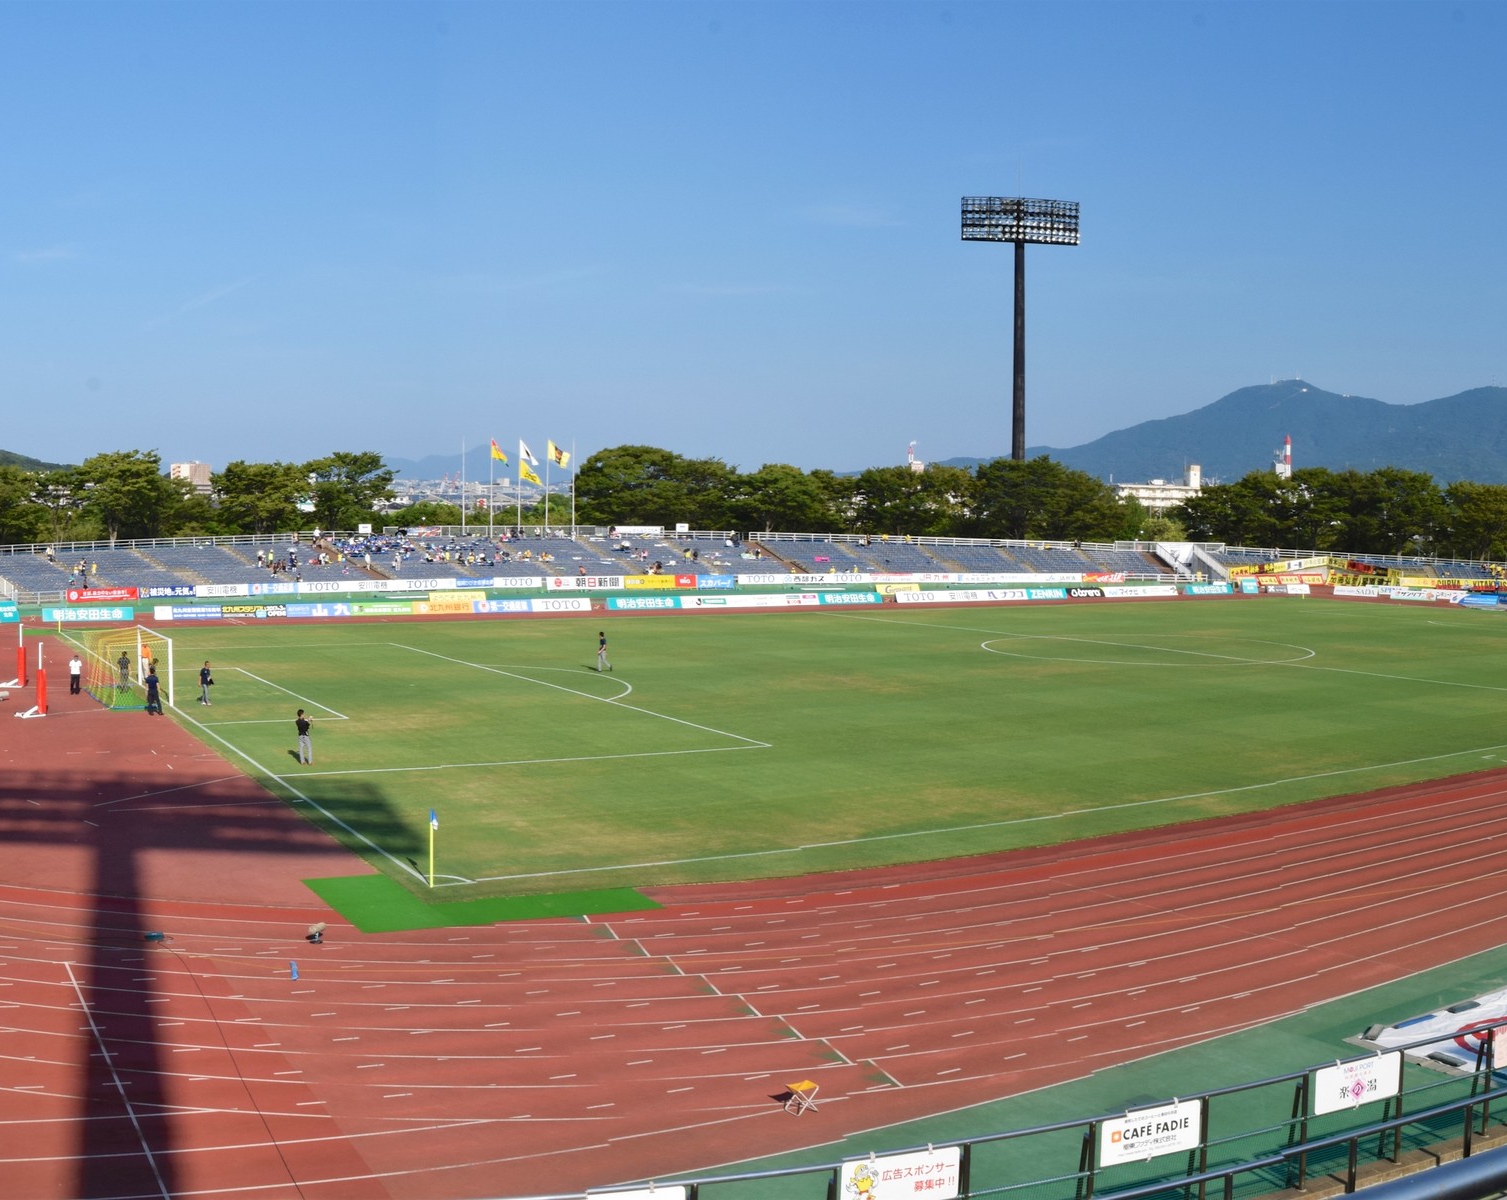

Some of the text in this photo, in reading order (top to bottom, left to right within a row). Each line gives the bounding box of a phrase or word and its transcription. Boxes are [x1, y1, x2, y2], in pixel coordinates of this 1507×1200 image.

[502, 577, 533, 586] TOTO
[576, 577, 620, 587] 朝日新聞
[747, 575, 775, 583] TOTO
[834, 574, 863, 582] TOTO
[307, 582, 340, 591] TOTO
[358, 581, 388, 590] 安川電機
[406, 579, 438, 588] TOTO
[206, 585, 237, 594] 安川電機
[1030, 589, 1063, 599] ZENRIN
[824, 594, 875, 603] 明治安田生命
[904, 592, 935, 601] TOTO
[949, 592, 978, 600] 安川電機
[542, 600, 581, 610] TOTO
[616, 598, 674, 609] 明治安田生命
[52, 608, 123, 620] 明治安田生命
[1123, 1117, 1189, 1140] CAFÉ FADIE
[881, 1162, 955, 1181] 広告スポンサー
